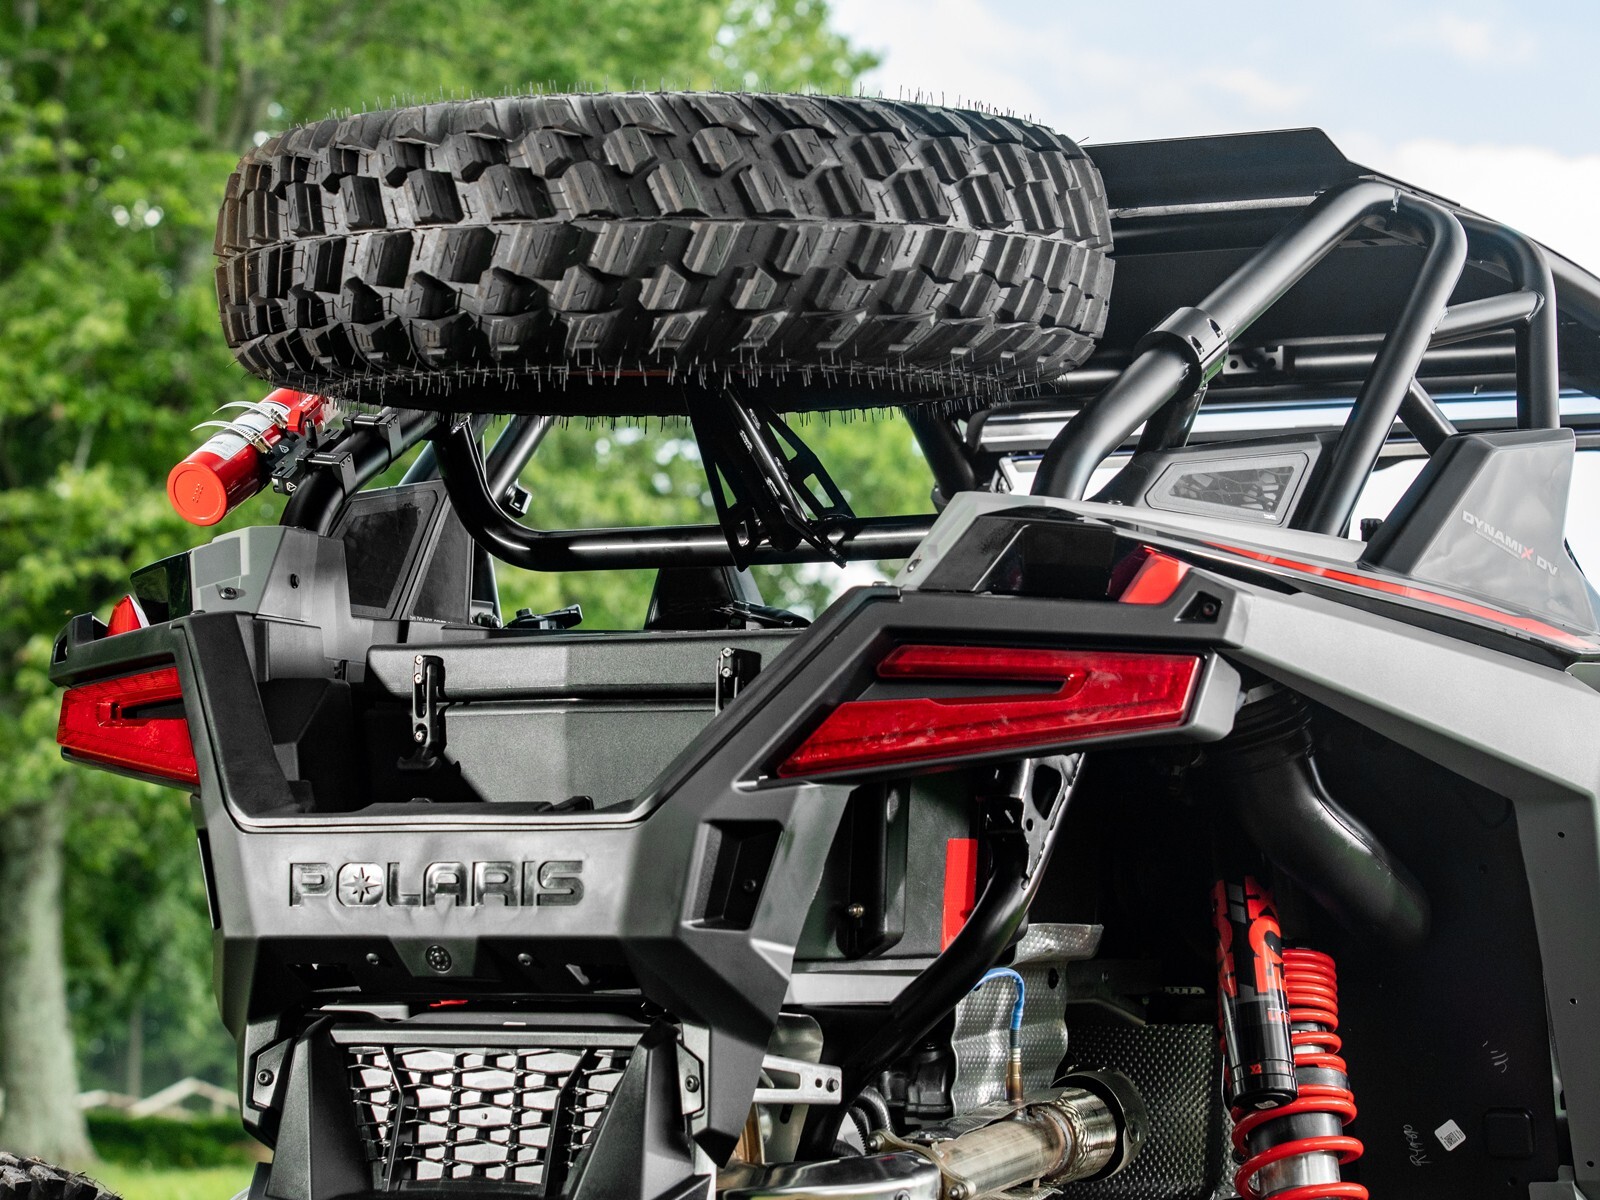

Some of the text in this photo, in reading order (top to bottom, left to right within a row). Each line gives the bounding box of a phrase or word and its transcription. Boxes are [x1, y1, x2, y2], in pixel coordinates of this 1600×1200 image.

[1462, 511, 1534, 560] DYNAMIX
[1537, 555, 1558, 575] DV
[289, 860, 584, 907] POLARIS
